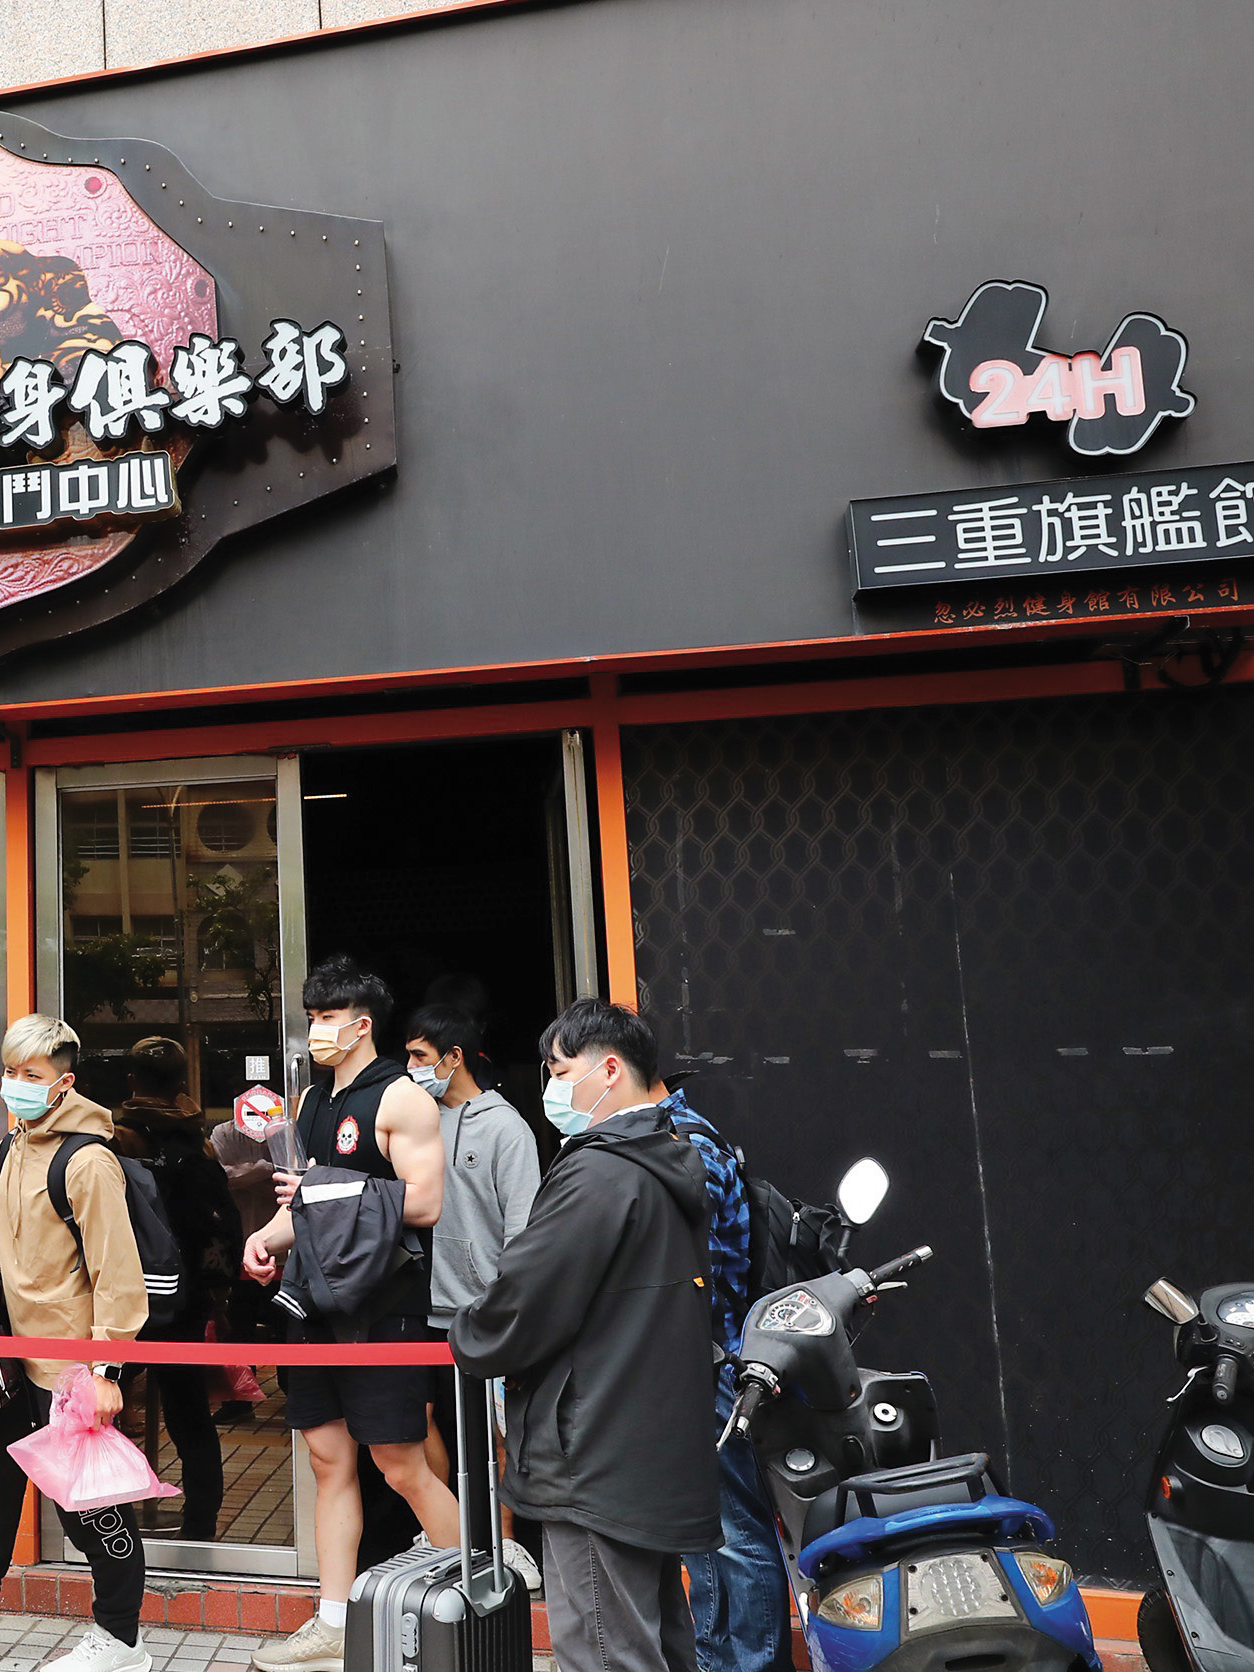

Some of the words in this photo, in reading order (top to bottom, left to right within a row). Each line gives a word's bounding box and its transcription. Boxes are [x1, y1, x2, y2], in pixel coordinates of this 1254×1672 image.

[969, 345, 1146, 428] 24H
[933, 577, 1240, 624] 忽必烈健身館有限公司
[248, 1056, 266, 1074] 推
